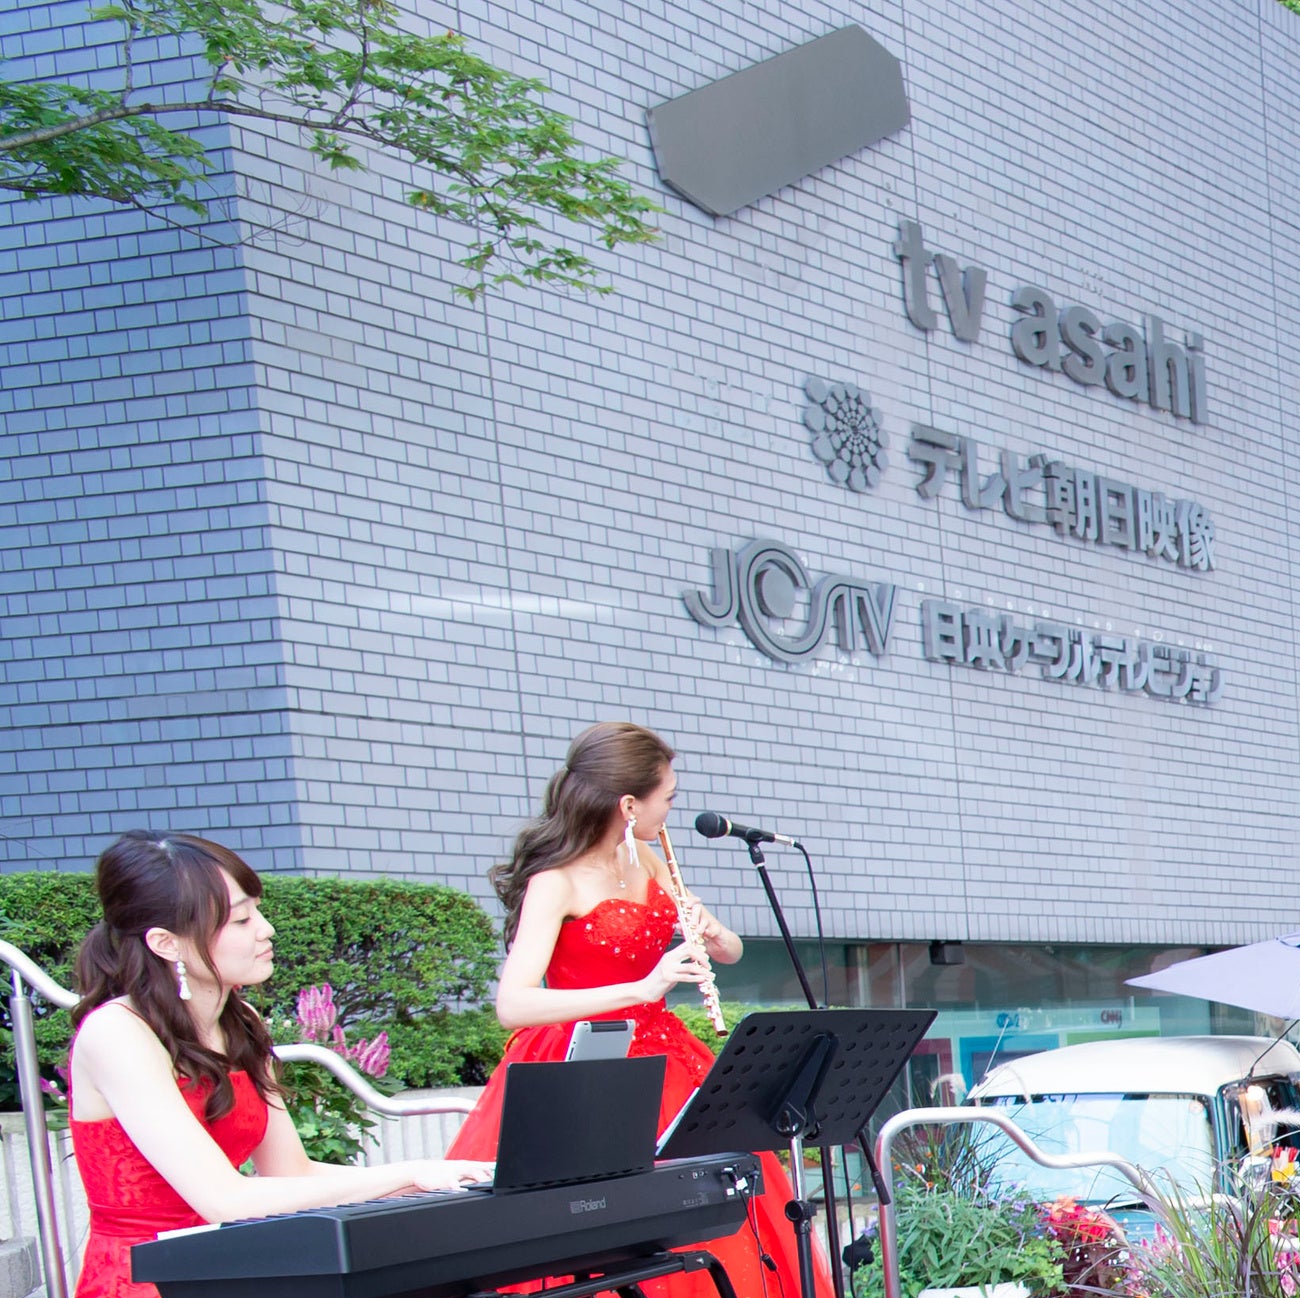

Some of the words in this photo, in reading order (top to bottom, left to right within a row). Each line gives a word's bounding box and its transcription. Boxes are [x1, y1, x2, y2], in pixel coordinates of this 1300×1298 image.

[893, 219, 987, 343] tv
[1011, 285, 1210, 425] asahi
[909, 424, 1218, 572] テレビ朝日映像
[921, 599, 1226, 706] 日本ケーブルテレビジョン
